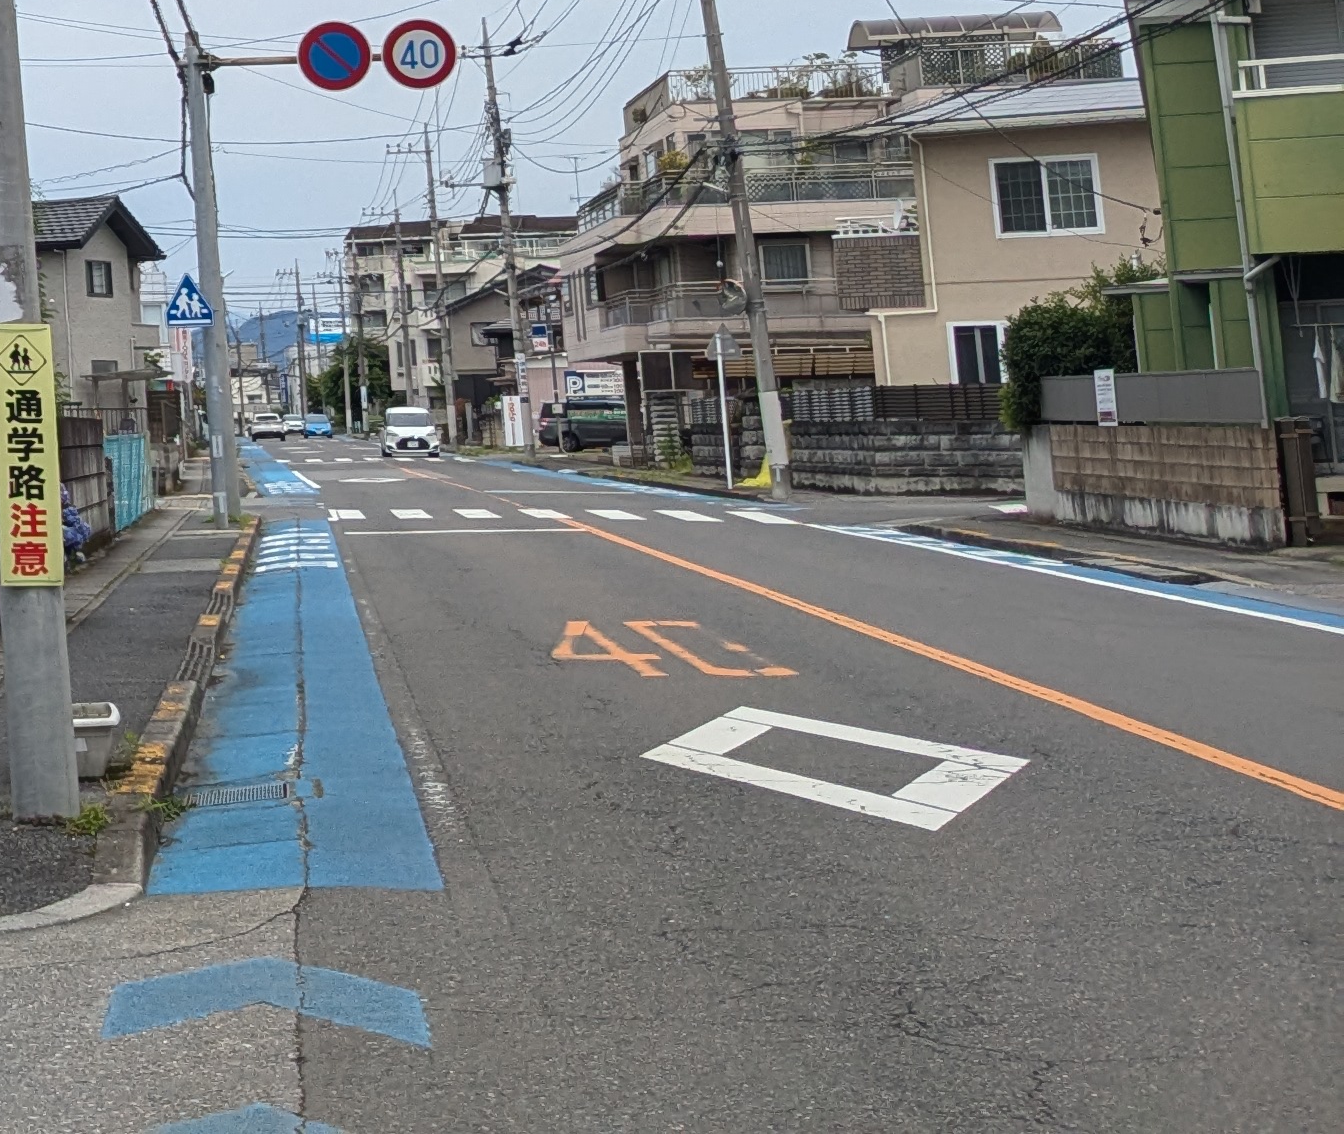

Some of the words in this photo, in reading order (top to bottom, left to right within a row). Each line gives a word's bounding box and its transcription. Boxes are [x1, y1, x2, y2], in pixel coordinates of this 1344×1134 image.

[399, 39, 440, 70] 40
[4, 388, 50, 577] 通学路注意
